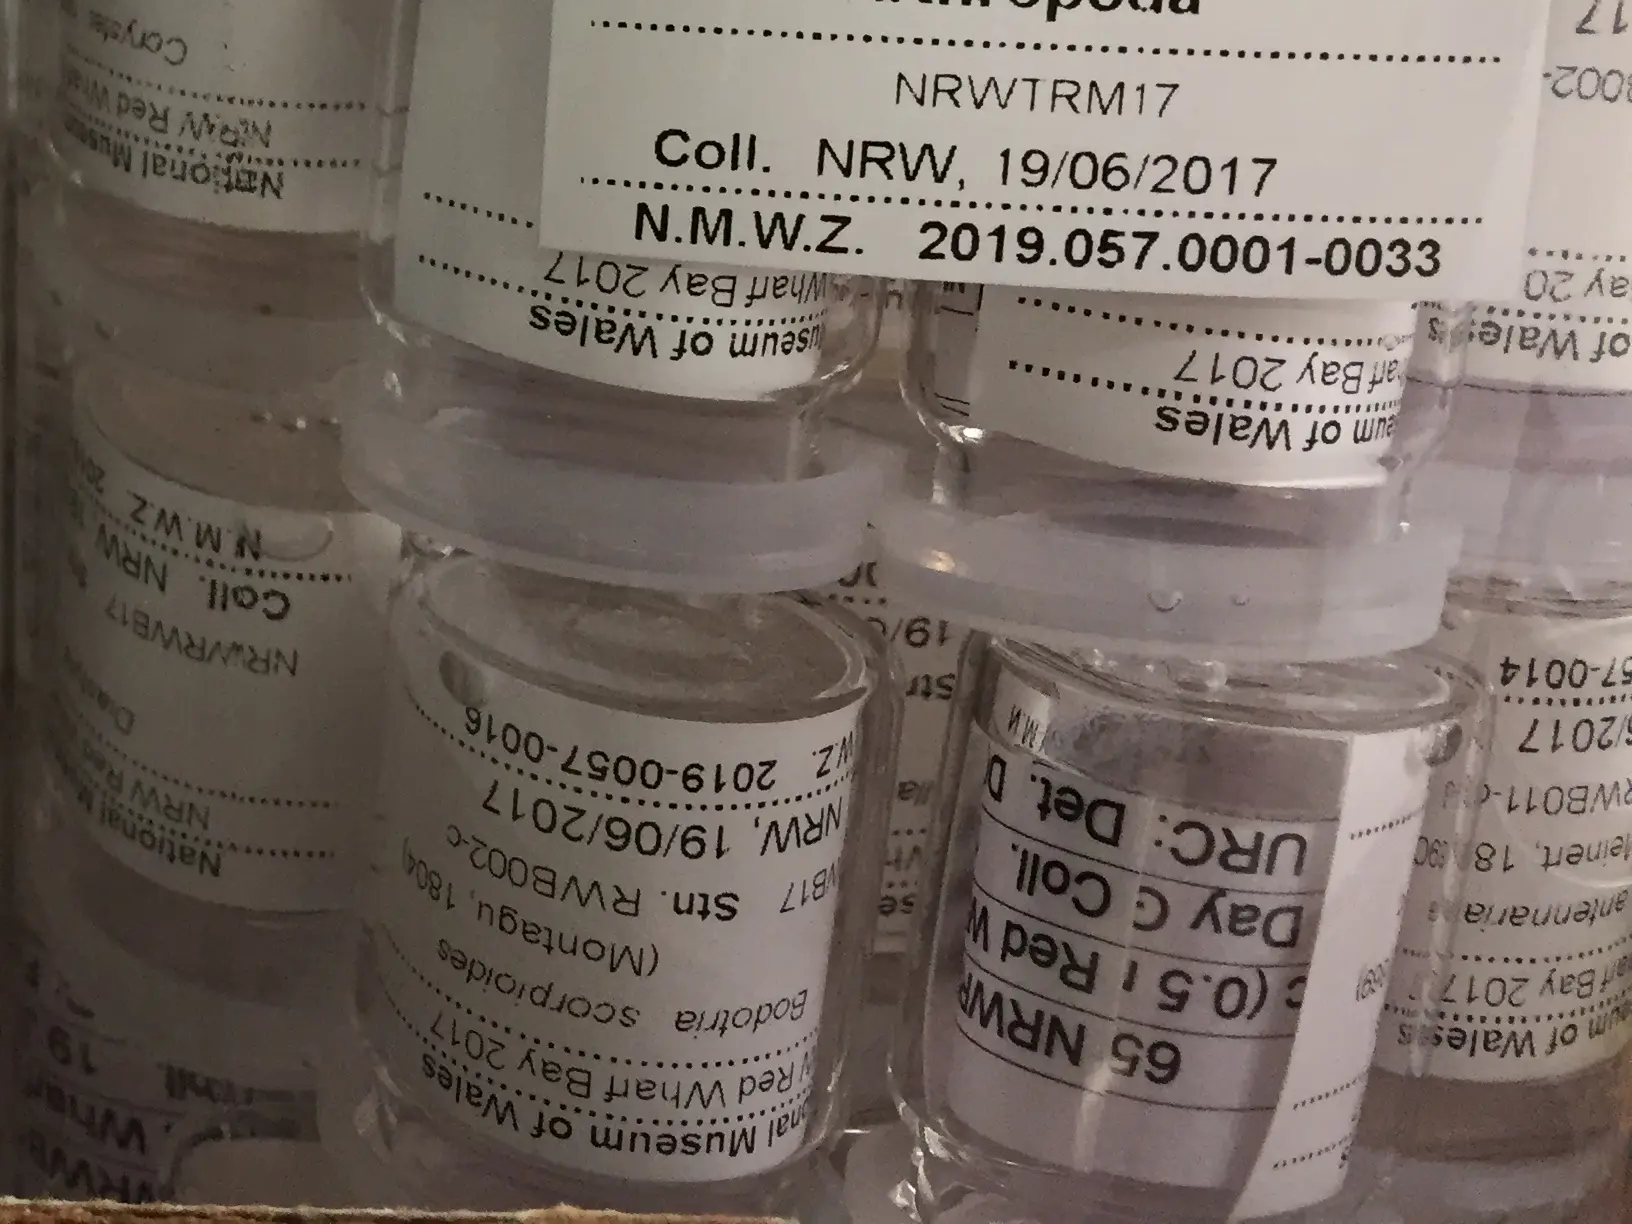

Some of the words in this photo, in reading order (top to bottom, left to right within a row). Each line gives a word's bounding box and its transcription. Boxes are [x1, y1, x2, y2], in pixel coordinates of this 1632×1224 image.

[116, 90, 171, 135] Red
[896, 72, 1179, 117] NRWTRM17
[655, 129, 770, 173] Coll.
[818, 140, 966, 189] NRW,
[998, 149, 1279, 196] 19/06/2017
[635, 204, 864, 255] N.M.W.Z.
[918, 222, 1442, 277] 2019.057.0001-0033
[543, 251, 649, 298] 2017
[660, 264, 737, 307] Bay
[528, 304, 658, 359] Wales
[670, 330, 713, 361] of
[1172, 350, 1286, 392] 2017
[1296, 351, 1364, 394] Bay
[1154, 405, 1291, 452] Wales
[1304, 420, 1342, 451] of
[199, 576, 291, 621] Coll.
[464, 705, 778, 793] 2019-0057-0016
[482, 778, 729, 859] 19/06/2017
[753, 796, 844, 857] NRW,
[1030, 773, 1126, 845] Det.
[446, 822, 641, 917] RWB002-c
[1152, 815, 1308, 876] URC:
[1010, 842, 1113, 918] Coll.
[660, 890, 740, 922] Stn.
[1189, 895, 1305, 948] Day
[1463, 889, 1629, 930] antennaria
[469, 889, 659, 977] (Montagu,
[1002, 920, 1101, 994] Red
[437, 939, 641, 1030] scorpioides
[1156, 964, 1268, 1021] (0.5
[1538, 964, 1596, 1003] Bay
[674, 989, 808, 1038] Bodotria
[429, 1012, 506, 1069] 2017
[1109, 1033, 1183, 1085] 65
[1545, 1022, 1578, 1056] of
[420, 1053, 519, 1133] Wales
[517, 1047, 593, 1098] Bay
[603, 1077, 726, 1110] Wharf
[738, 1063, 794, 1105] Red
[533, 1112, 573, 1148] of
[590, 1125, 756, 1158] Museum
